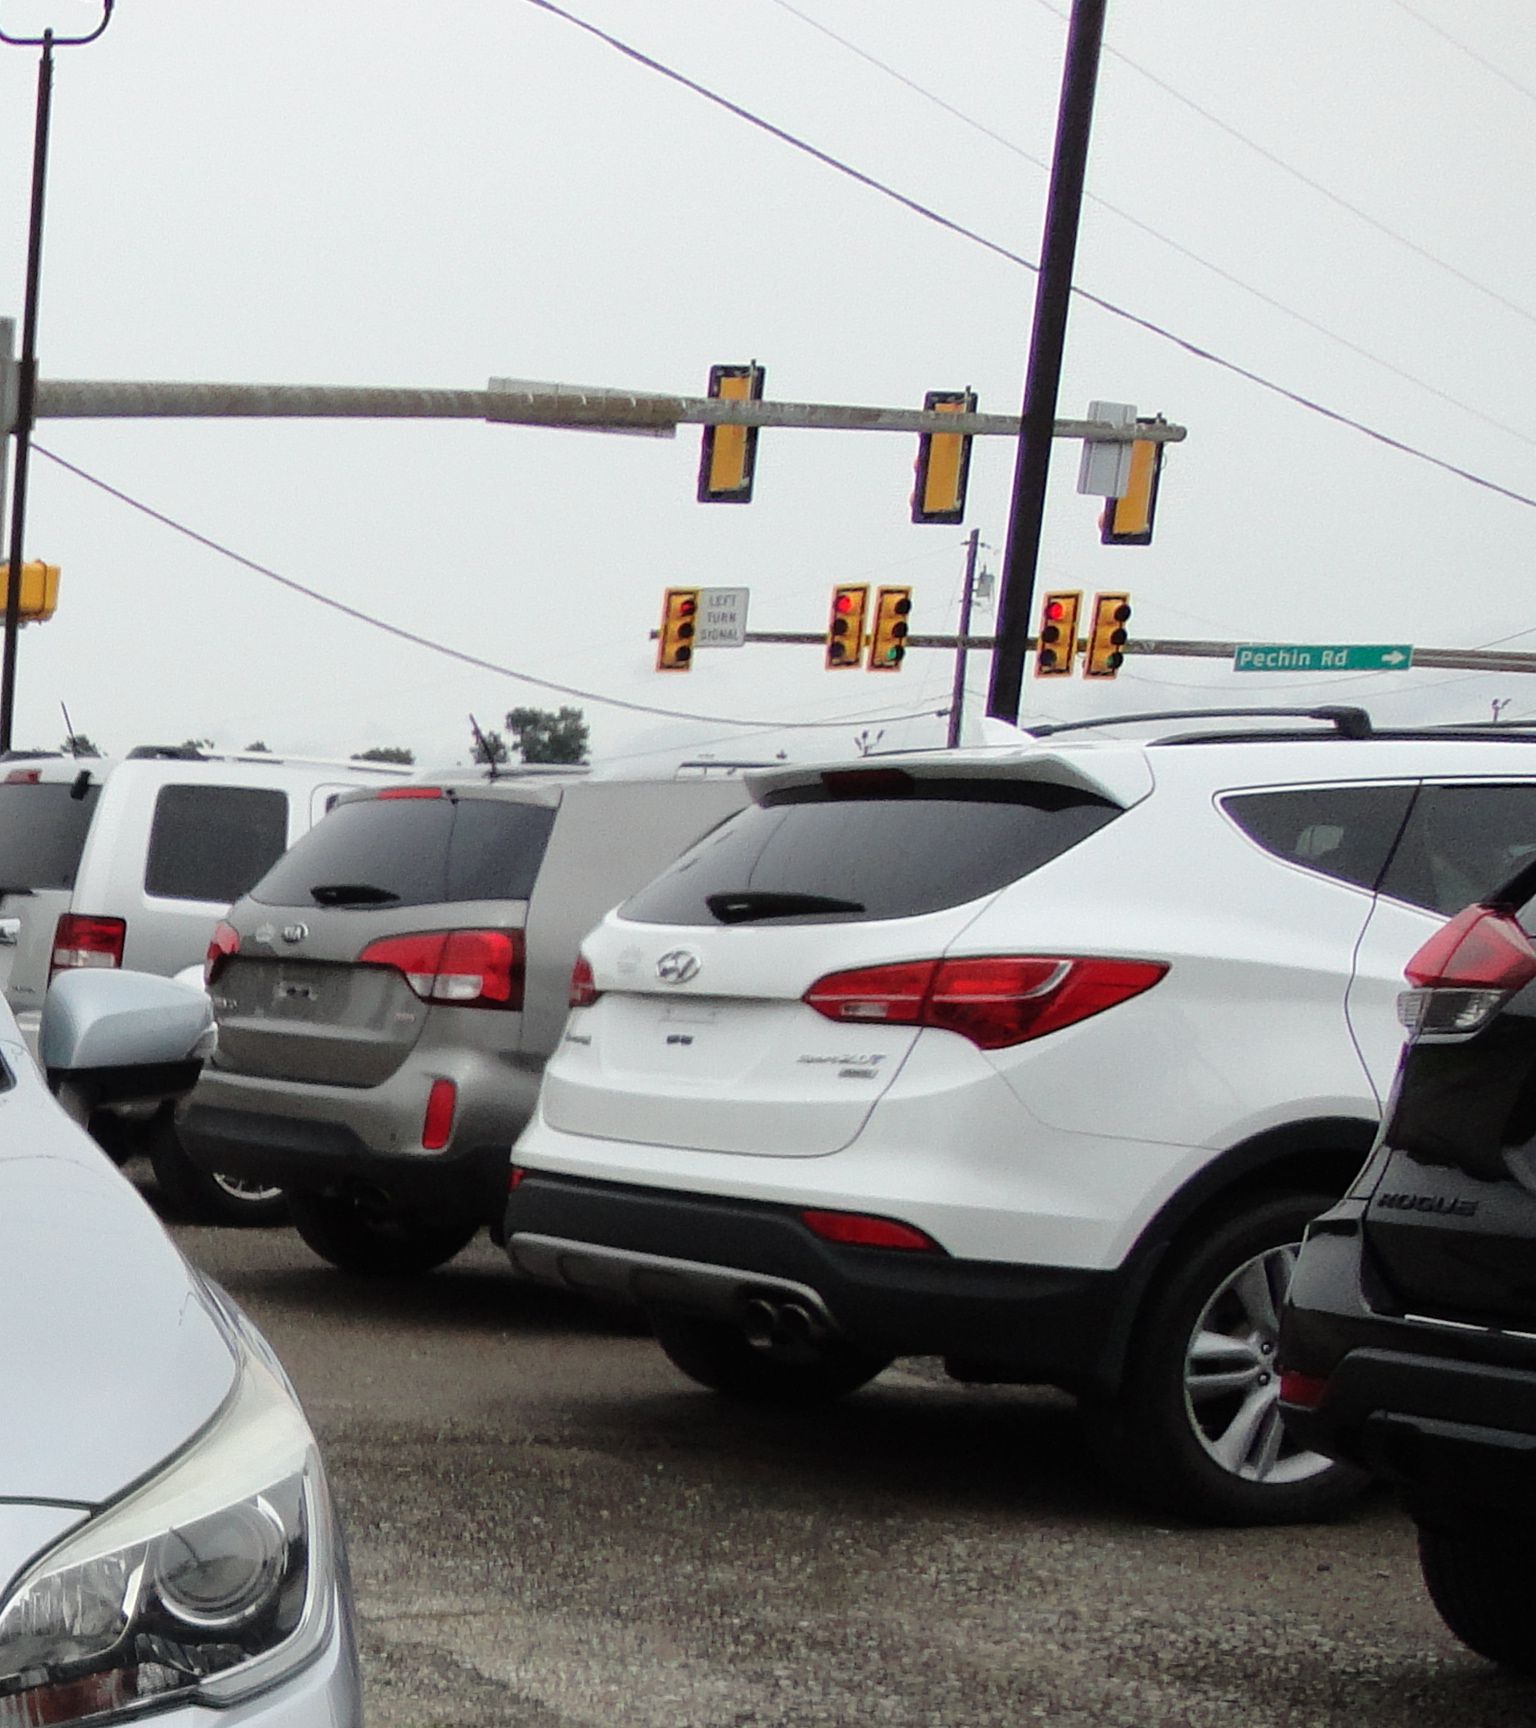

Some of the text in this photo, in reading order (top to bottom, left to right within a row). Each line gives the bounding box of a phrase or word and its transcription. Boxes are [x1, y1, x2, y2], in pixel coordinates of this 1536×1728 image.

[709, 594, 736, 607] LEFT
[1239, 648, 1349, 667] Pechin Rd
[1377, 1193, 1479, 1217] ROGUE
